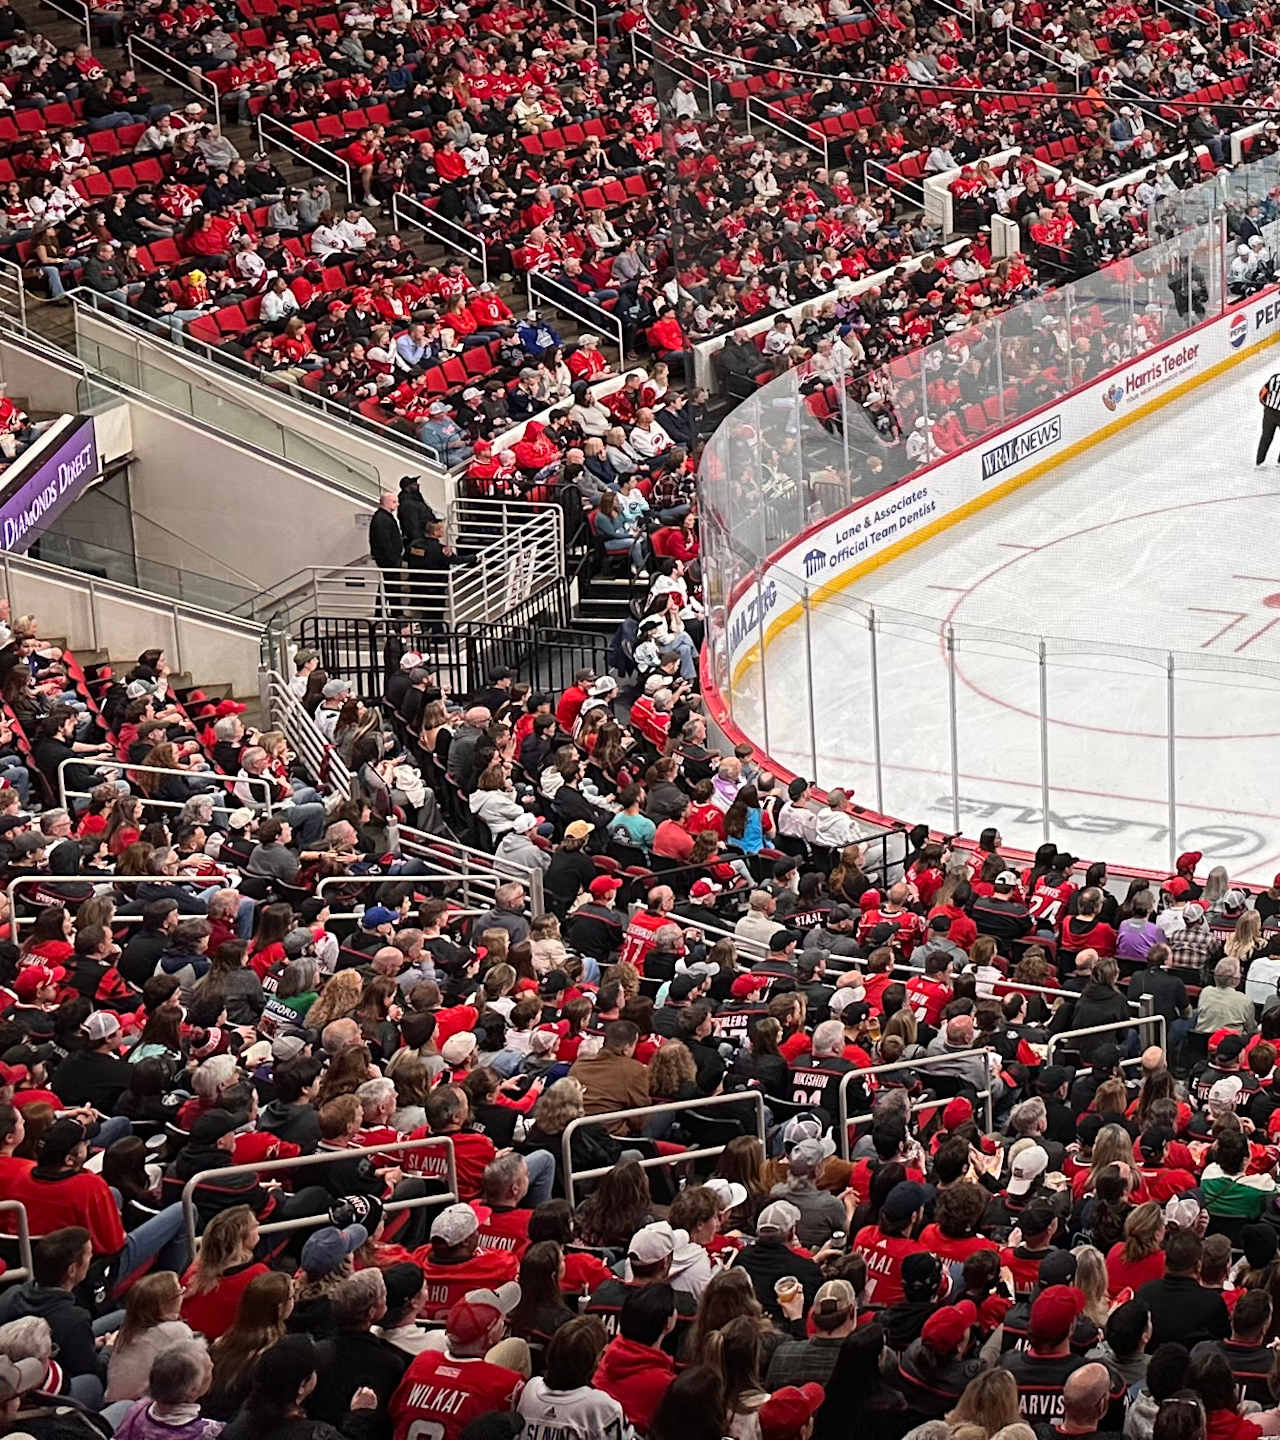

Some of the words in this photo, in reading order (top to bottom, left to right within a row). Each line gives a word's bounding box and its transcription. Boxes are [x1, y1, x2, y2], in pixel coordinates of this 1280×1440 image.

[1125, 363, 1162, 394] Harris
[1162, 345, 1200, 377] Teeter
[983, 438, 1018, 479] WRAL
[1020, 423, 1060, 456] NEWS
[4, 479, 57, 551] DIAMONDS
[58, 444, 92, 494] DIRECT
[835, 524, 862, 545] Lane
[864, 517, 871, 527] &
[874, 487, 928, 523] Associates
[829, 537, 869, 568] Official
[870, 522, 897, 548] Team
[900, 500, 936, 528] Dentist
[932, 795, 1171, 844] LEXUS
[795, 912, 823, 926] STAAL
[1030, 896, 1062, 920] 24
[409, 1155, 448, 1175] SLAVIN
[406, 1384, 470, 1414] WILKAT
